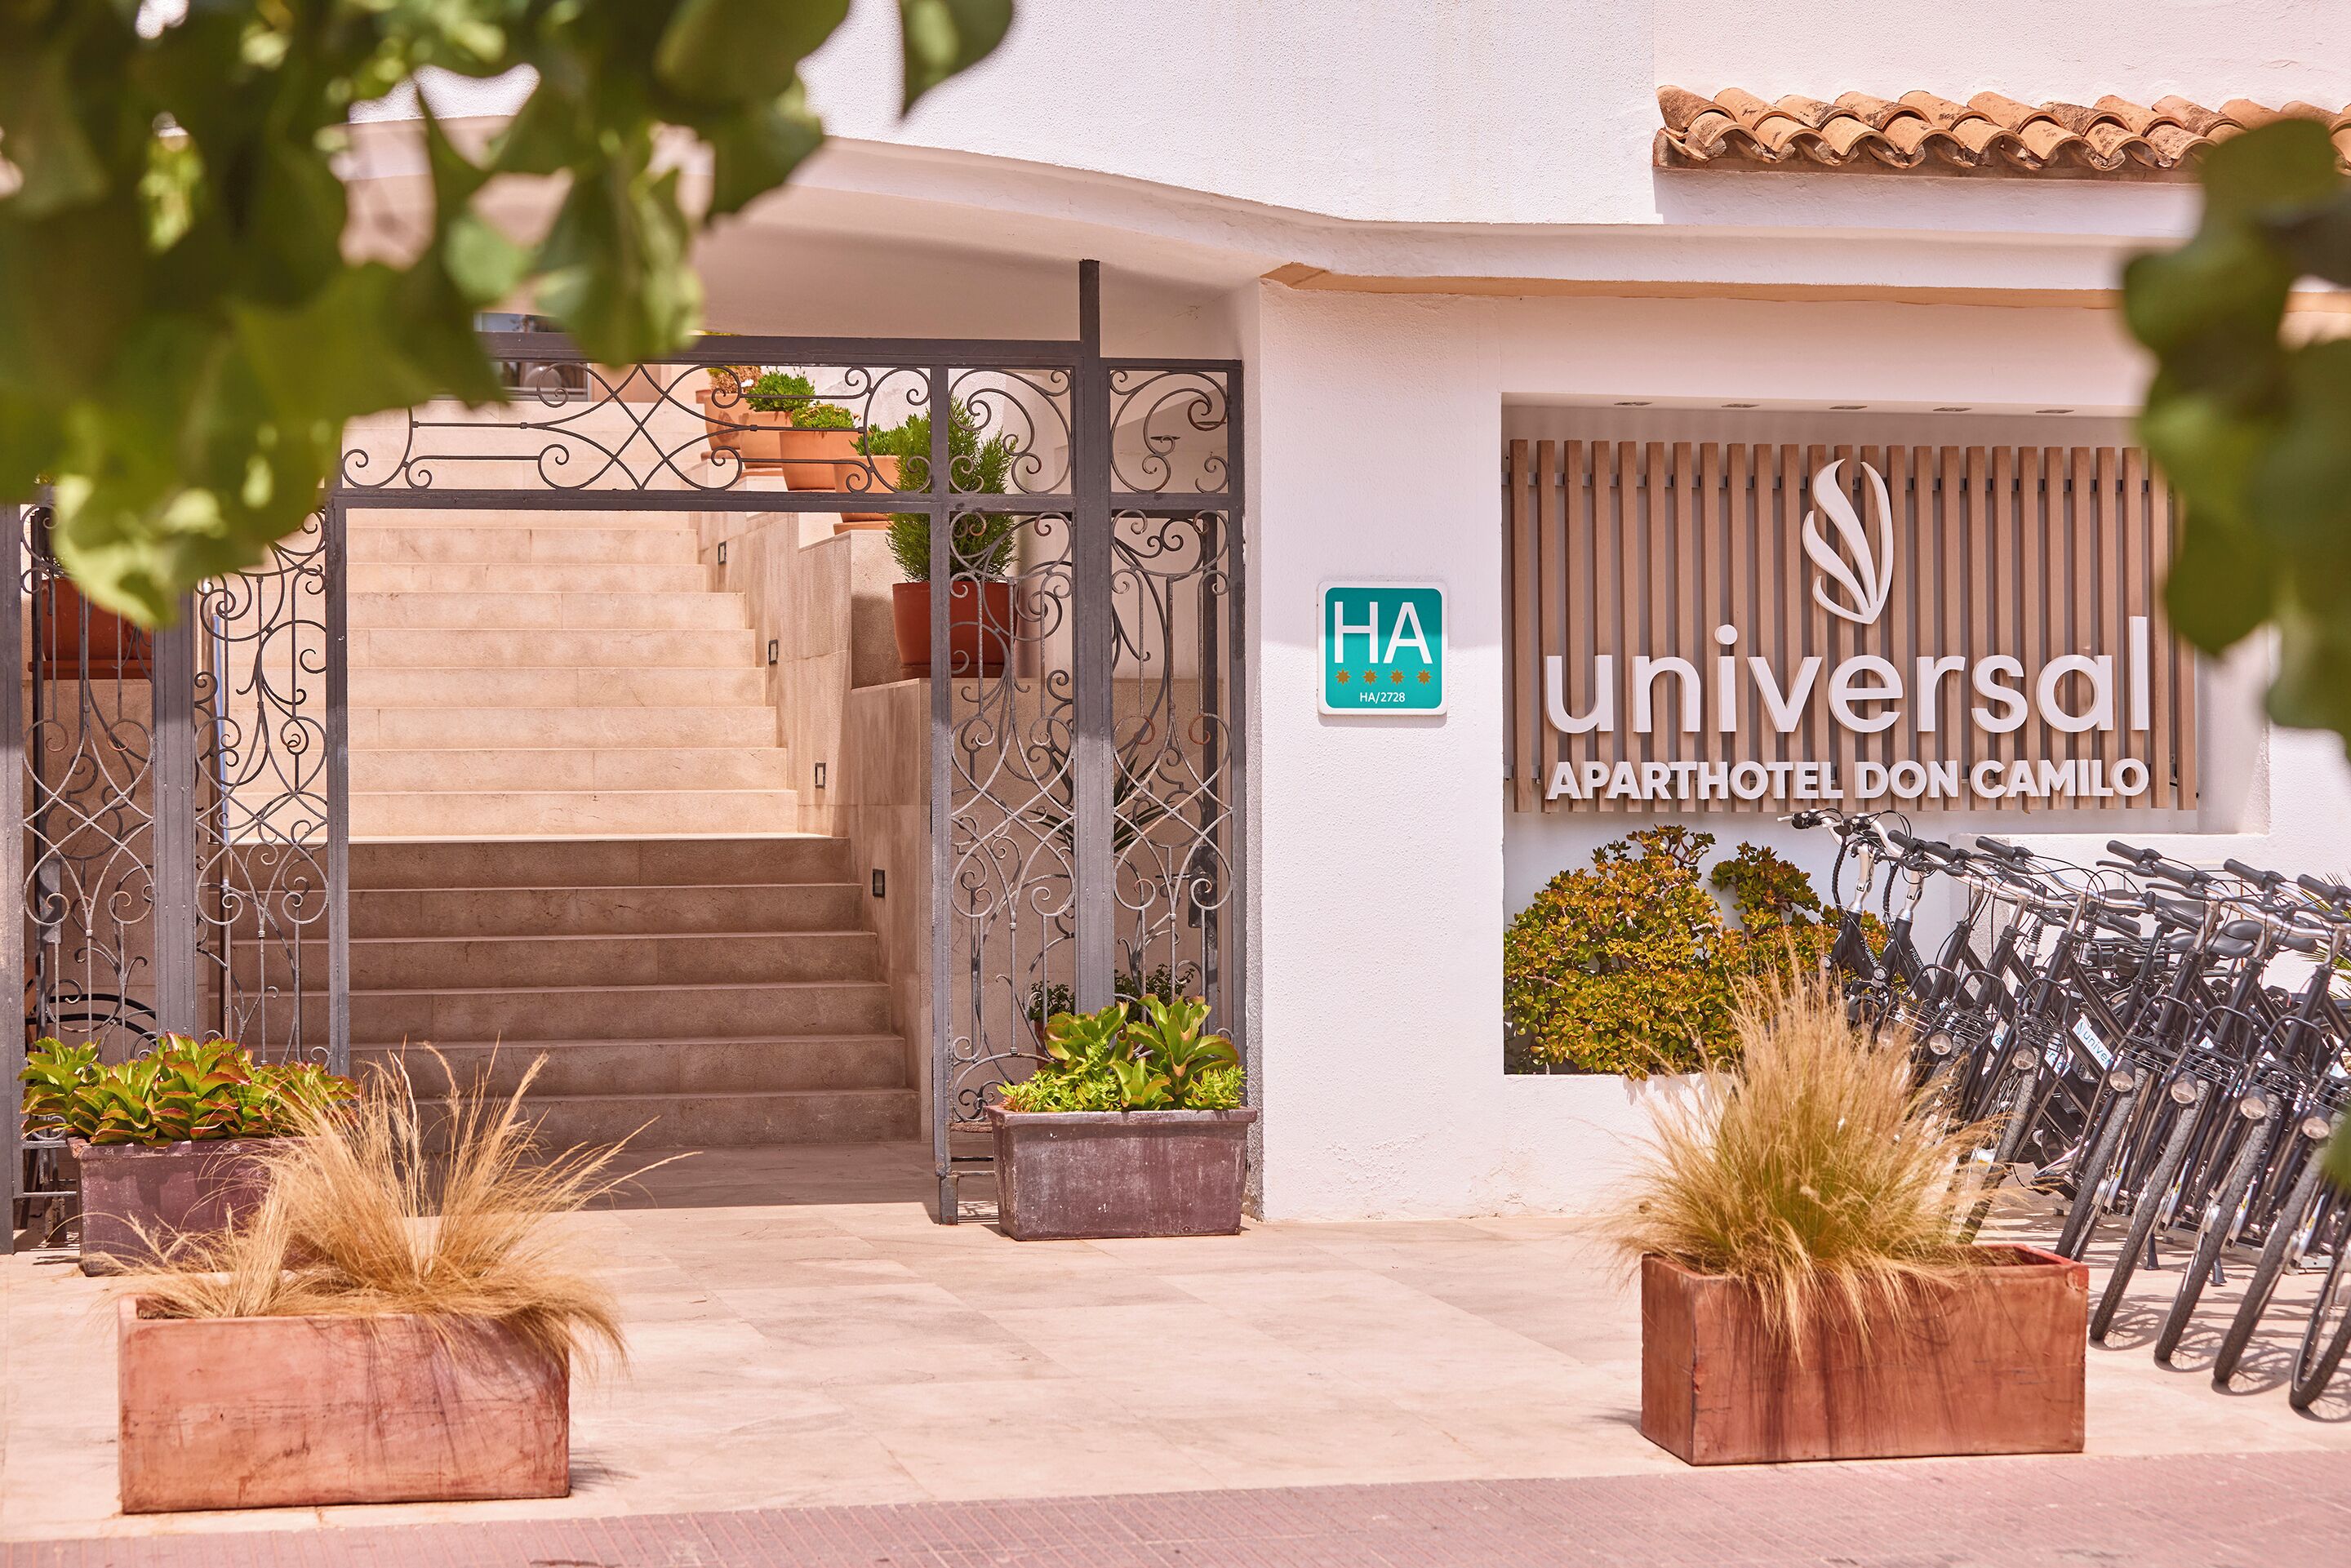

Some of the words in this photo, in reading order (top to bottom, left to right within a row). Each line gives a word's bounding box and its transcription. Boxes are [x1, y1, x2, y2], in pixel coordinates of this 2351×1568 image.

[1334, 601, 1433, 664] HA
[1545, 616, 2149, 734] universal
[1359, 692, 1406, 704] HA/2728
[1545, 761, 1844, 800] APARTHOTEL
[1855, 760, 1958, 799] DON
[1970, 757, 2149, 798] CAMILO
[2083, 1029, 2112, 1066] univer
